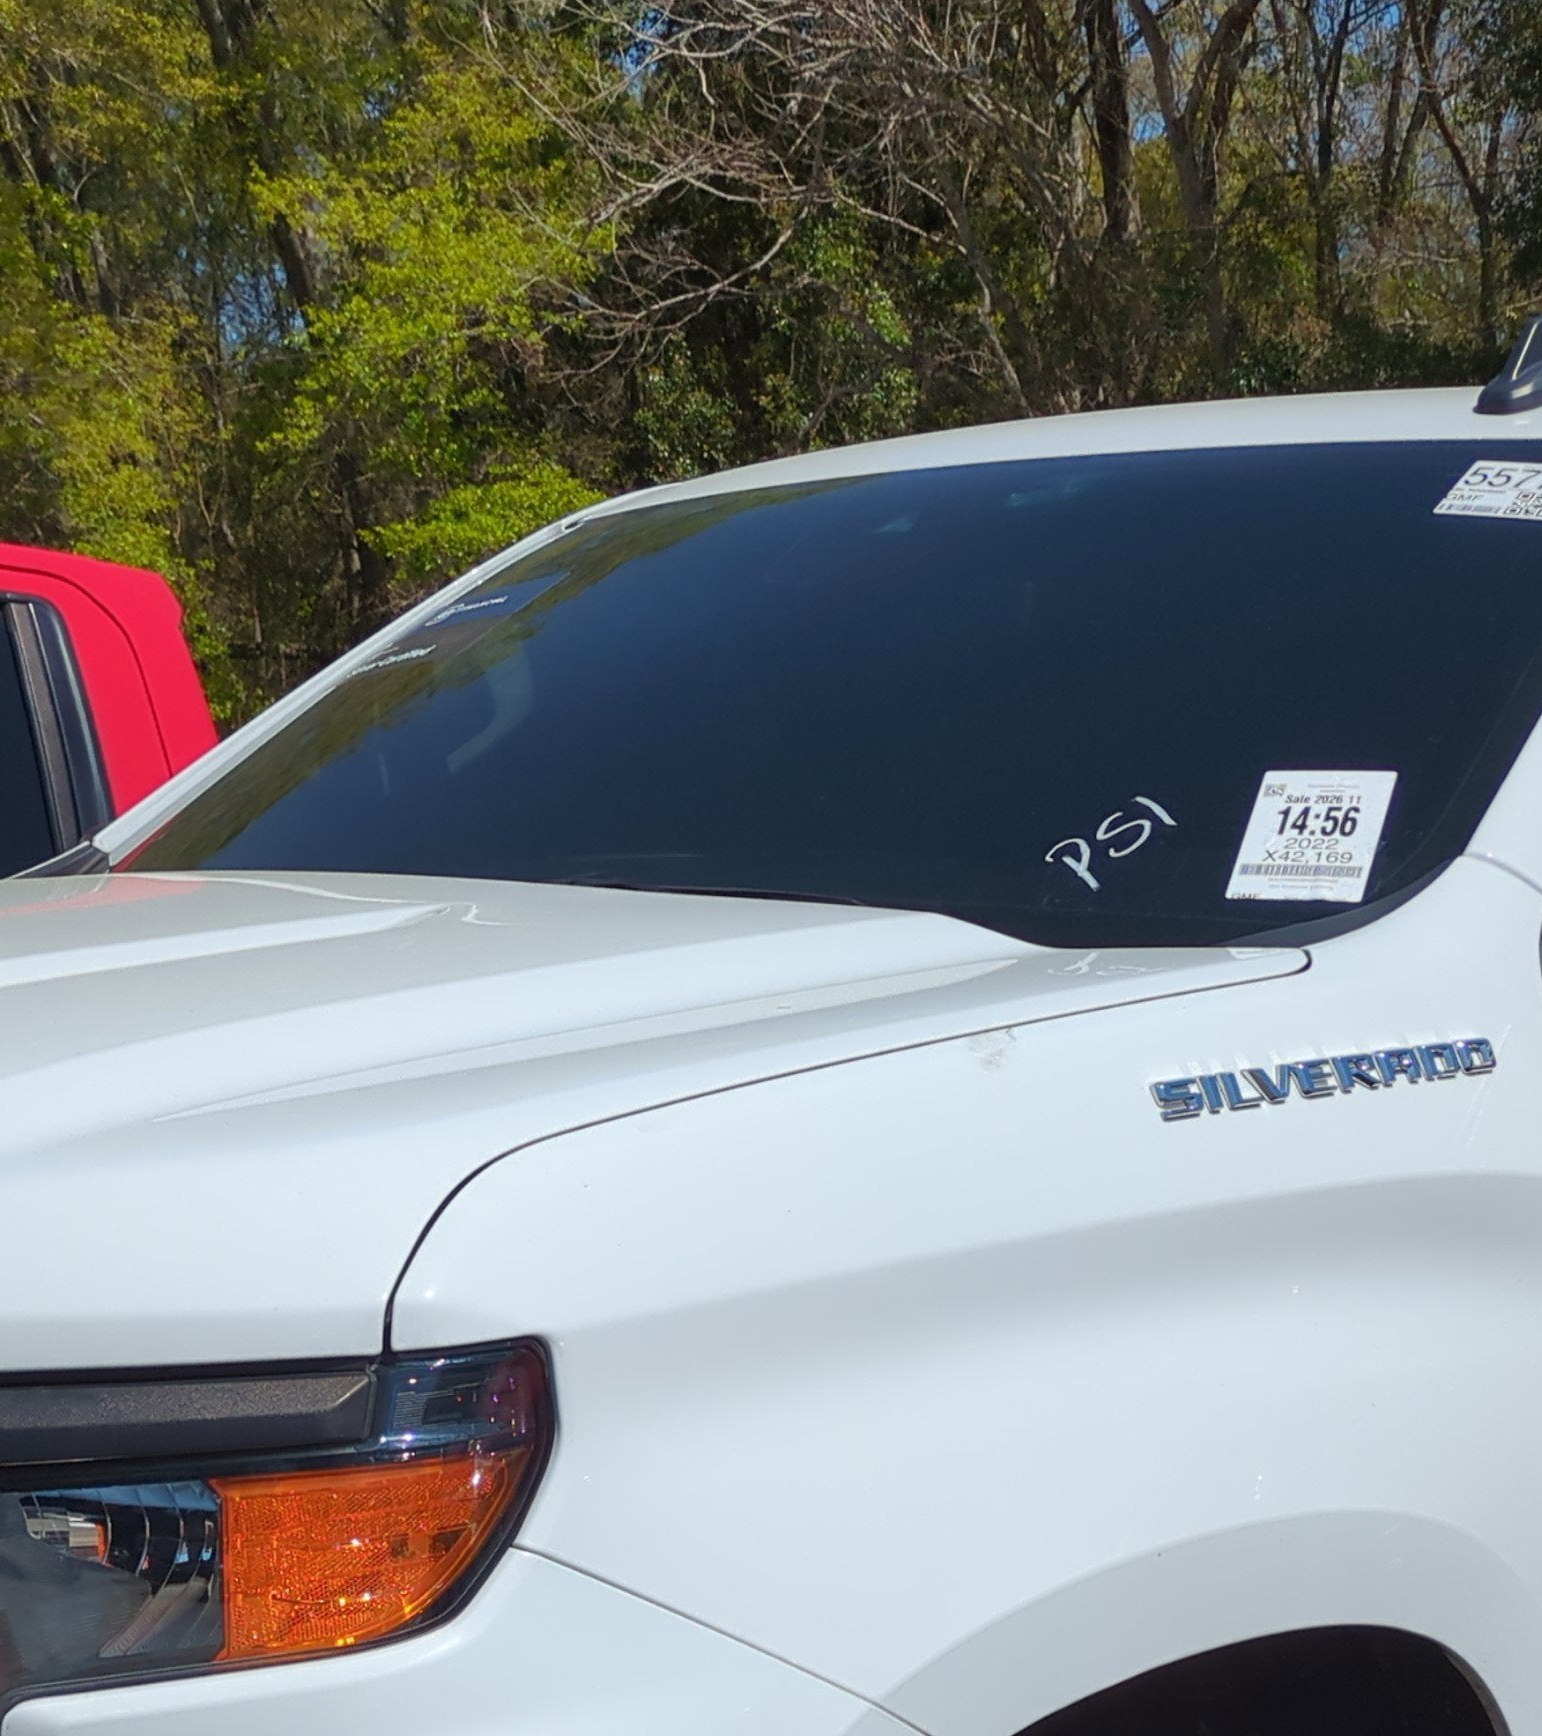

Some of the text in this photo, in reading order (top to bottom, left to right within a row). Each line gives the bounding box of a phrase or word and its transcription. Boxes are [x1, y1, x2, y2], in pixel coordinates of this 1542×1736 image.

[1285, 794, 1311, 804] Sale
[1277, 806, 1361, 837] 14:56
[1284, 838, 1340, 850] 2022
[1262, 850, 1353, 864] X42,169
[1150, 1037, 1498, 1122] SILVERADO
